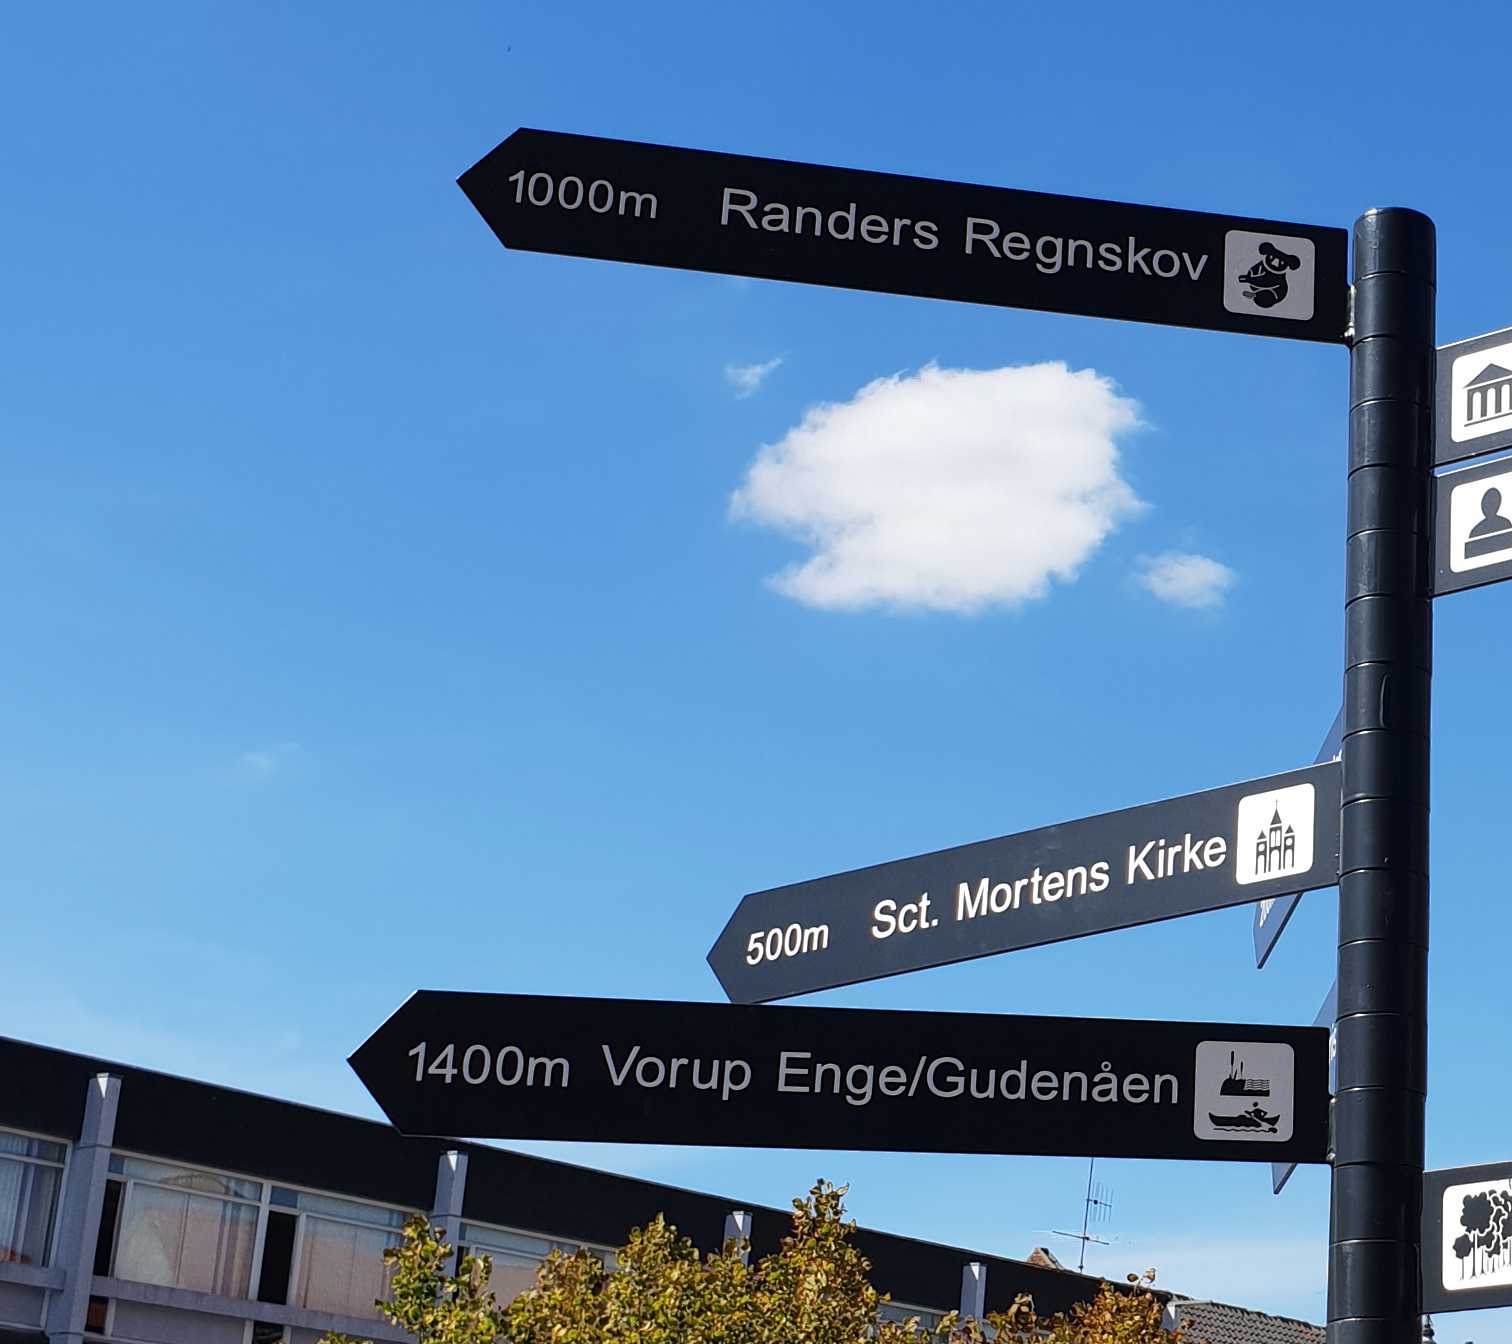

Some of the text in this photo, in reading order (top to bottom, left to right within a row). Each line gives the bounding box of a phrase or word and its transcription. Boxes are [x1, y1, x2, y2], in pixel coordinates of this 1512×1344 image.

[508, 169, 1209, 281] 1000m Randers Regnskov
[746, 833, 1227, 965] 500m Sct. Mortens Kirke
[408, 1041, 1179, 1106] 1400m Vorup Enge/Gudenåen
